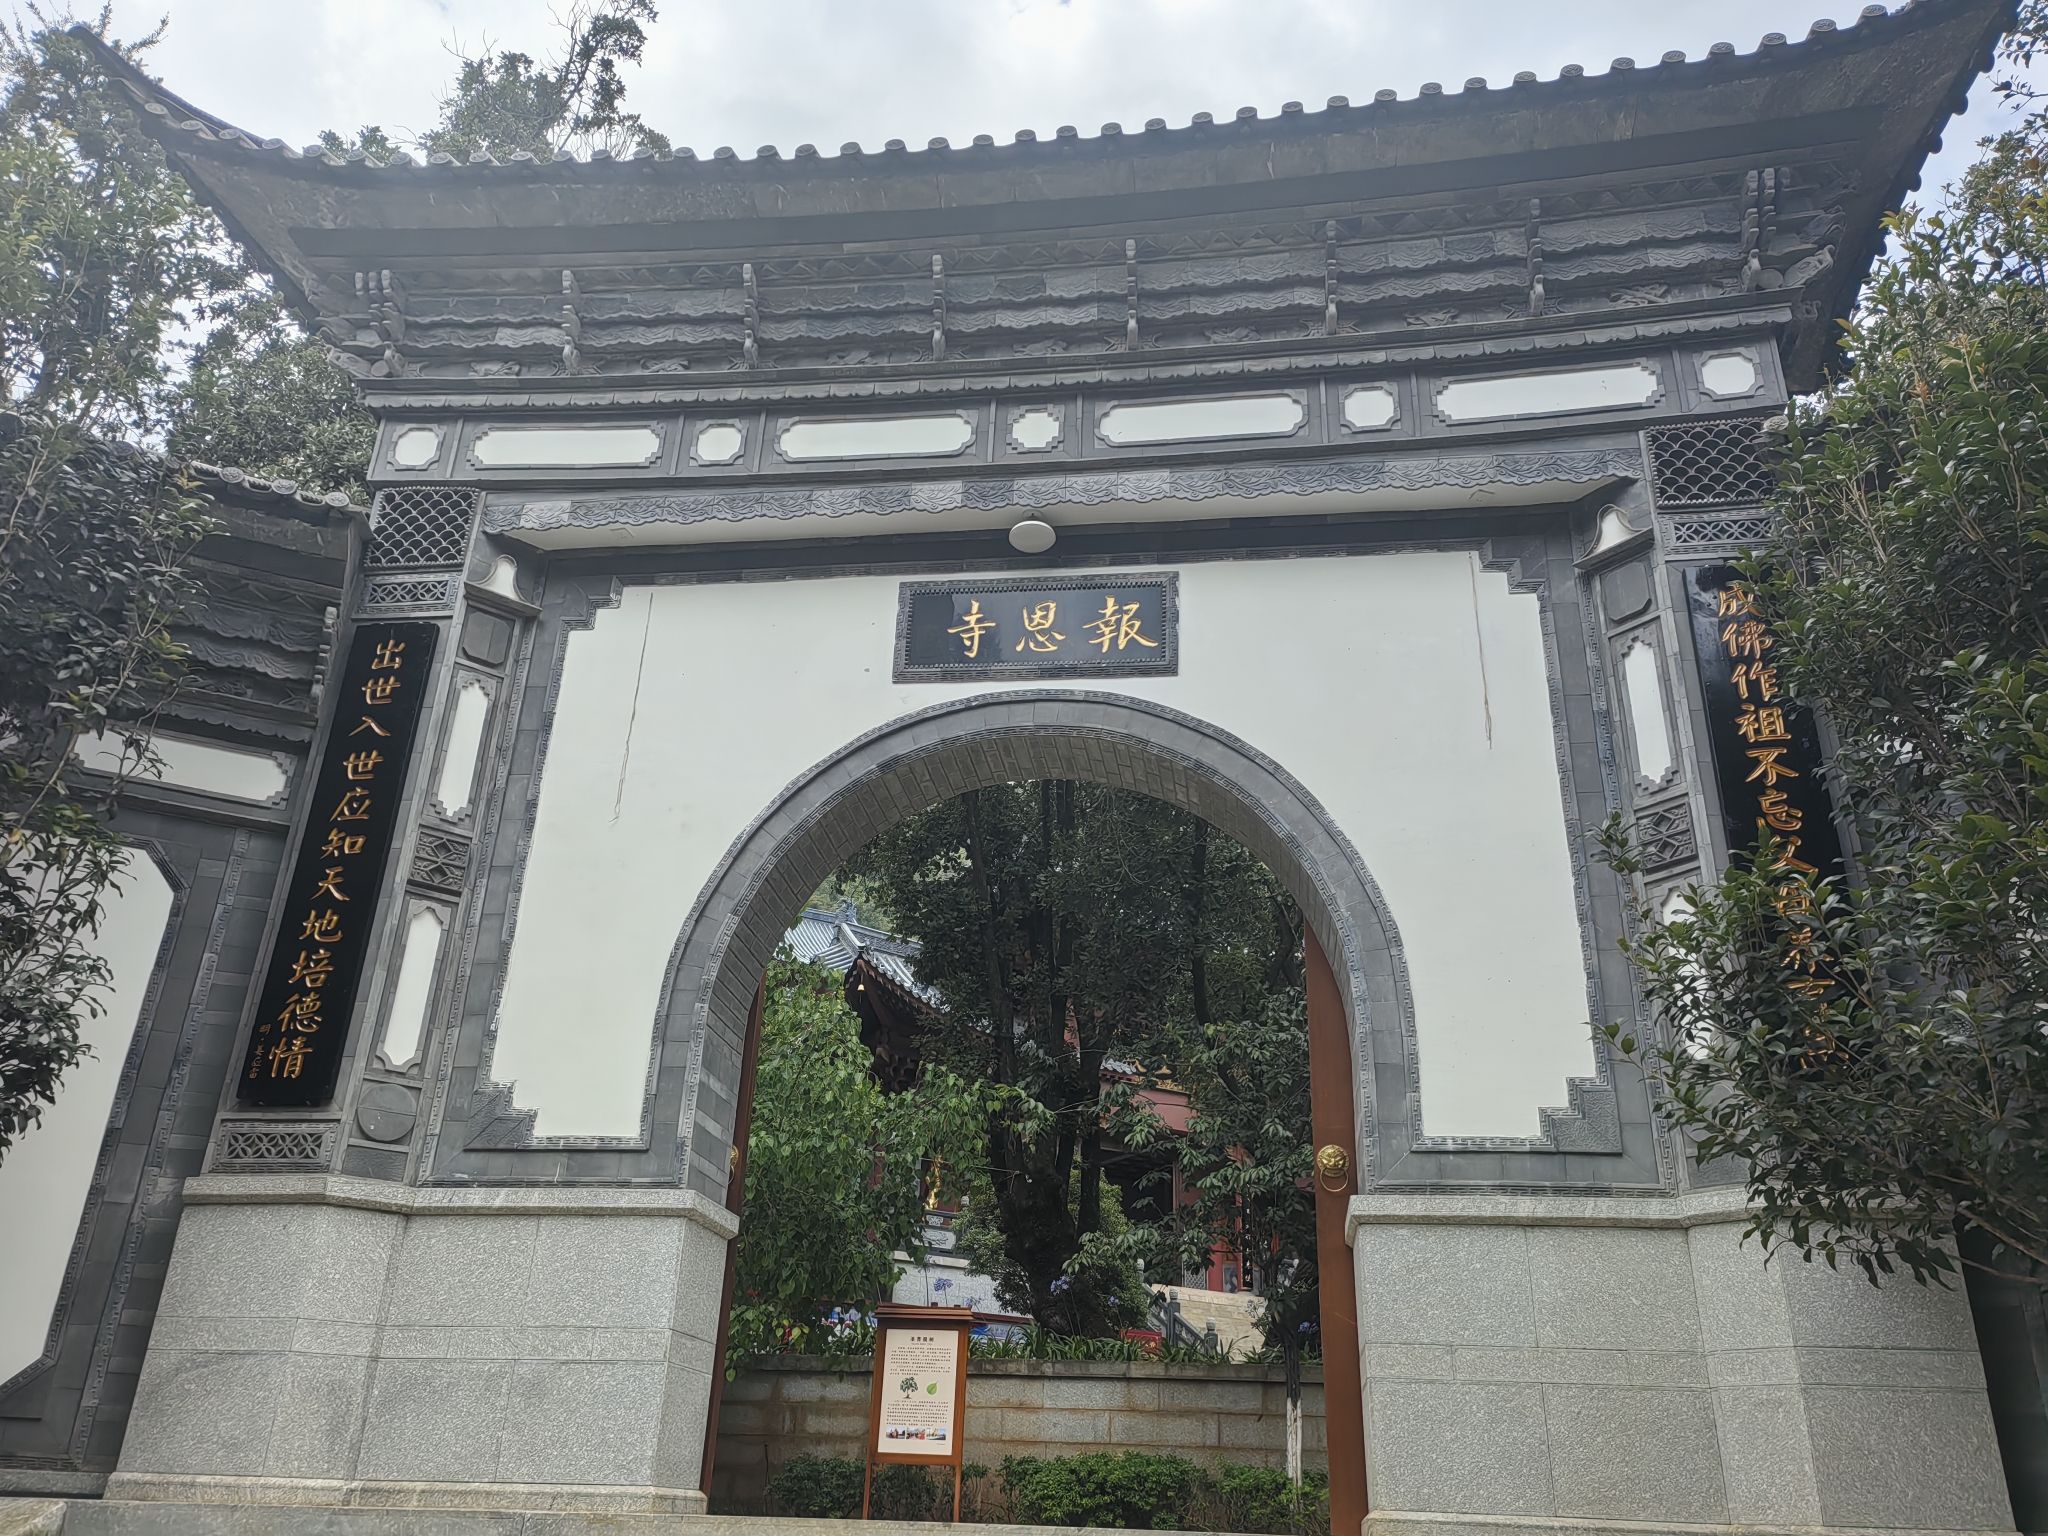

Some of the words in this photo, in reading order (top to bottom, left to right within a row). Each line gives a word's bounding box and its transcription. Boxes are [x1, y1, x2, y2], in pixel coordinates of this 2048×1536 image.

[947, 594, 1159, 659] 報恩寺
[267, 637, 407, 1079] 出世入世应知天地培德情
